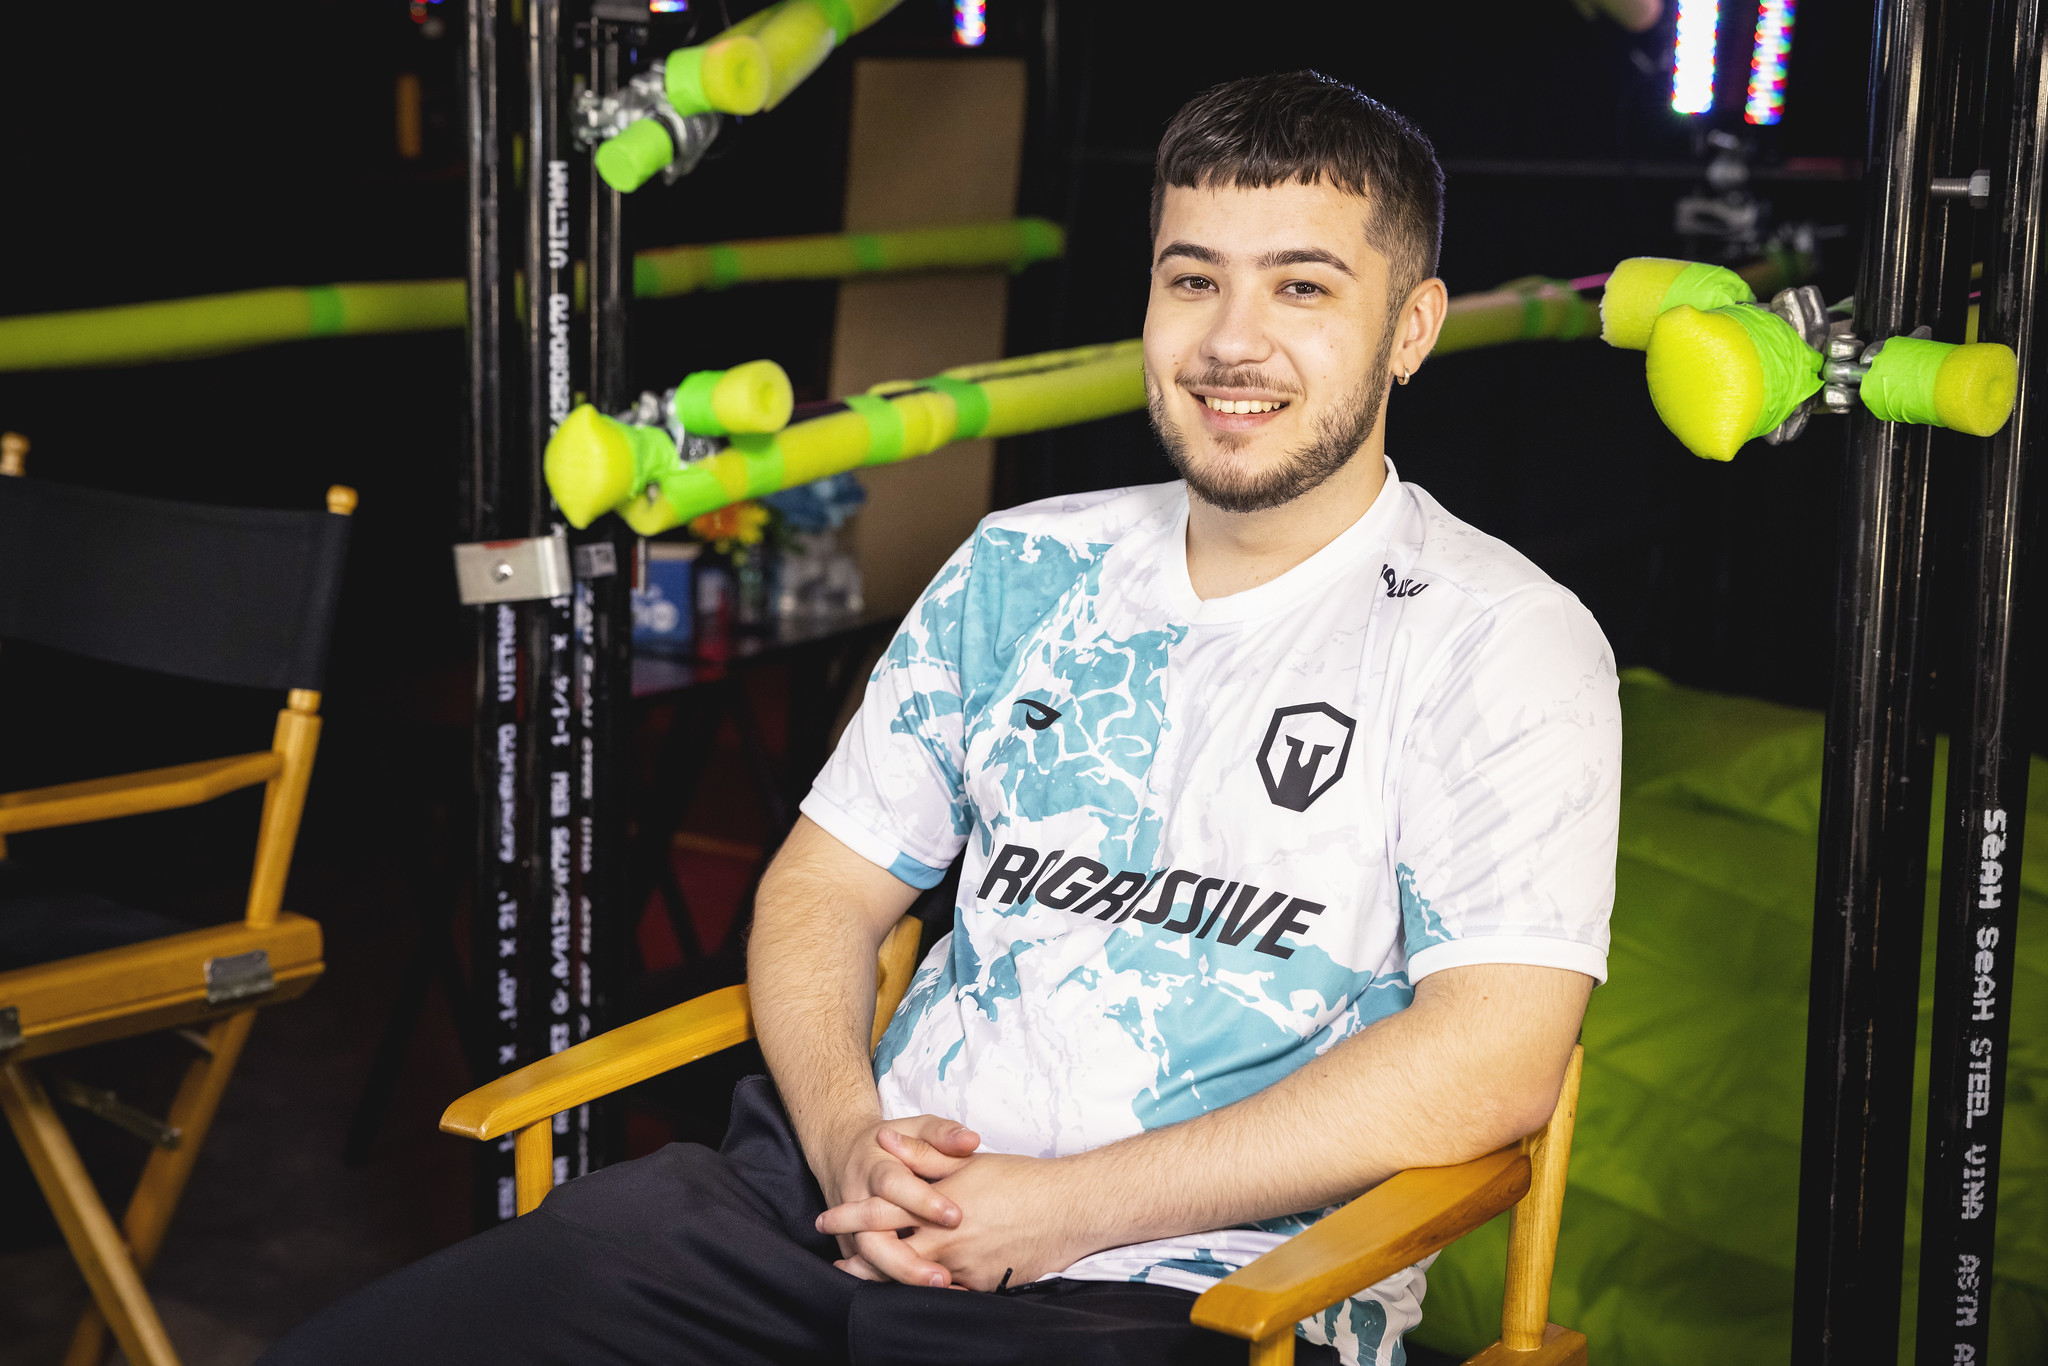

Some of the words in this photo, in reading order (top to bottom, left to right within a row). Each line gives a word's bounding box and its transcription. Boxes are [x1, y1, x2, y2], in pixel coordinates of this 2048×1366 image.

[547, 159, 570, 269] VIETNAM
[1965, 1037, 1992, 1129] STEEL
[1961, 1144, 1986, 1220] VINA
[1955, 1254, 1980, 1327] ASTM
